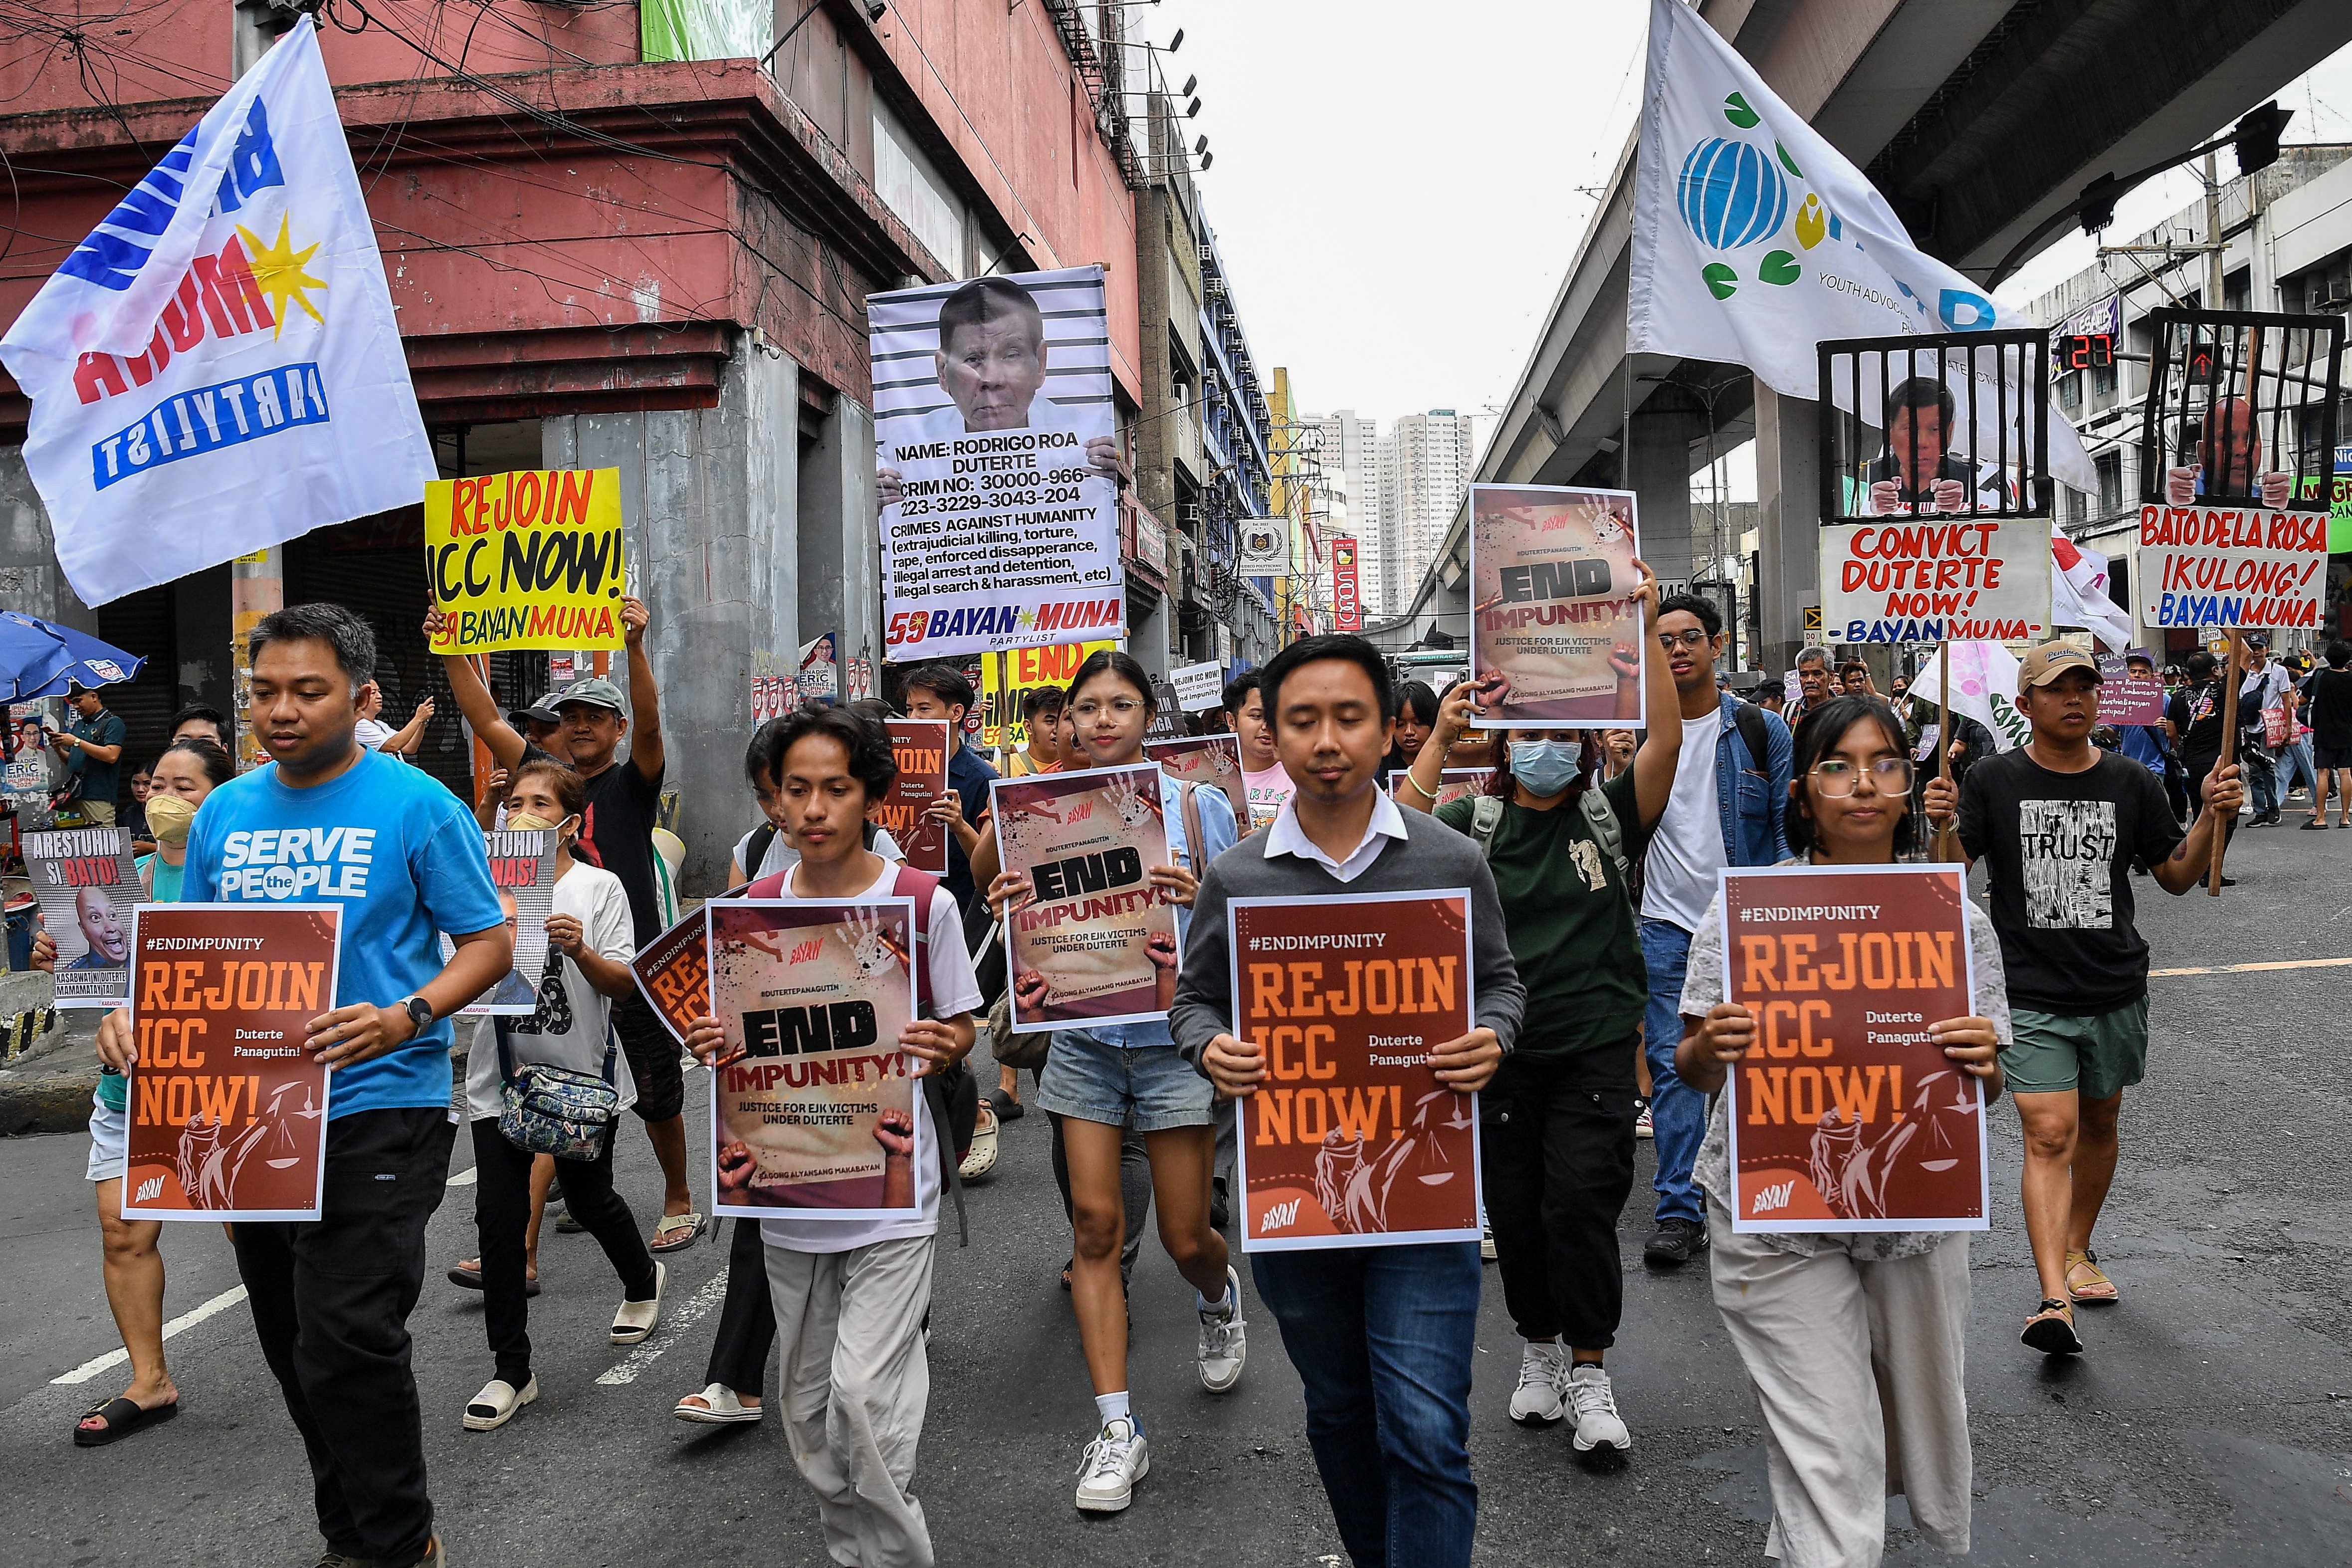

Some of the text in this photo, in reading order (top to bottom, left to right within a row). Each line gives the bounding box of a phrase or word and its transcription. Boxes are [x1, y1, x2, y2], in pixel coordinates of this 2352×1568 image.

[1819, 271, 1861, 297] YOUTH
[2072, 335, 2112, 369] 27
[895, 432, 1079, 462] NAME: RODRIGO ROA
[953, 453, 1037, 474] DUTERTE
[900, 468, 1091, 497] CRIM NO: 30000-966-
[449, 469, 593, 538] REJOIN
[901, 486, 1081, 517] 223-3229-3043-204
[890, 508, 1096, 538] CRIMES AGAINST HUMANITY
[1541, 512, 1569, 532] BAYAN
[2141, 505, 2200, 547] BATO
[2267, 513, 2327, 552] ROSA
[892, 525, 1078, 555] (extrajudicial killing, torture,
[1850, 522, 1999, 561] CONVICT
[427, 527, 622, 606] ICC NOW!
[892, 540, 1098, 571] rape, enforced dissapperance,
[893, 556, 1074, 584] illegal arrest and detention,
[894, 566, 1111, 599] illegal search & harassment, etc)
[1498, 558, 1612, 605] END
[1841, 558, 2004, 593] DUTERTE
[2161, 554, 2319, 597] IKULONG!
[1484, 598, 1633, 632] IMPUNITY!
[1884, 591, 1978, 618] NOW!
[433, 604, 615, 647] 59 BAYAN MUNA
[886, 599, 1120, 645] 59 BAYAN MUNA
[989, 634, 1057, 646] PARTYLIST
[1495, 637, 1533, 647] JUSTICE
[1534, 637, 1553, 646] FOR
[1572, 638, 1611, 646] VICTIMS
[1551, 646, 1592, 655] DUTERTE
[800, 673, 829, 683] ERIC
[1019, 643, 1083, 683] END
[1174, 676, 1193, 686] REJOIN
[1205, 670, 1220, 679] NOW!
[1189, 687, 1221, 699] Impunity!
[1538, 684, 1613, 697] ALYANSANG MAKABAYAN
[2099, 698, 2150, 708] ndustrialisasyon
[2121, 688, 2158, 697] Pambansang
[7, 763, 38, 774] ERIC
[1068, 799, 1094, 826] BAYAN
[33, 829, 121, 860] ARESTUHIN
[222, 827, 377, 868] SERVE
[484, 831, 544, 857] STUHIN
[2021, 833, 2115, 861] TRUST
[46, 857, 120, 887] SI BATO!
[266, 876, 292, 888] the
[1030, 846, 1143, 903] END
[1019, 887, 1168, 932] IMPUNITY!
[1739, 905, 1881, 923] #ENDIMPUNITY
[145, 937, 264, 951] #ENDIMPUNITY
[789, 936, 824, 966] BAYAN
[1031, 928, 1146, 946] JUSTICE FOR EJK VICTIMS
[1053, 938, 1128, 953] UNDER DUTERTE
[1248, 932, 1387, 952] #ENDIMPUNITY
[1739, 931, 1955, 992] REJOIN
[56, 971, 126, 983] KASABWAT NI DUTERTE
[56, 984, 113, 996] MAMAMATAY TAO
[141, 960, 325, 1012] REJOIN
[1078, 976, 1152, 995] ALYANSANG MAKABAYAN
[1248, 955, 1458, 1018] REJOIN
[742, 999, 879, 1059] END
[1745, 999, 1833, 1059] ICC
[1865, 1011, 1923, 1024] Duterte
[137, 1018, 208, 1069] ICC
[234, 1028, 284, 1041] Duterte
[1368, 1034, 1423, 1047] Duterte
[1867, 1031, 1932, 1047] Panaguti
[233, 1045, 301, 1059] Panagutin!
[1252, 1024, 1336, 1082] ICC
[727, 1051, 906, 1094] IMPUNITY!
[136, 1075, 261, 1127] NOW!
[738, 1102, 877, 1114] JUSTICE FOR EJK VICTIMS
[1746, 1065, 1907, 1126] NOW!
[763, 1114, 854, 1125] UNDER DUTERTE
[1254, 1085, 1406, 1146] NOW!
[790, 1163, 880, 1178] ALYANSANG MAKABAYAN
[135, 1174, 167, 1204] BAYAN
[1751, 1179, 1795, 1214] BAYAN
[1261, 1197, 1301, 1233] BAYAN
